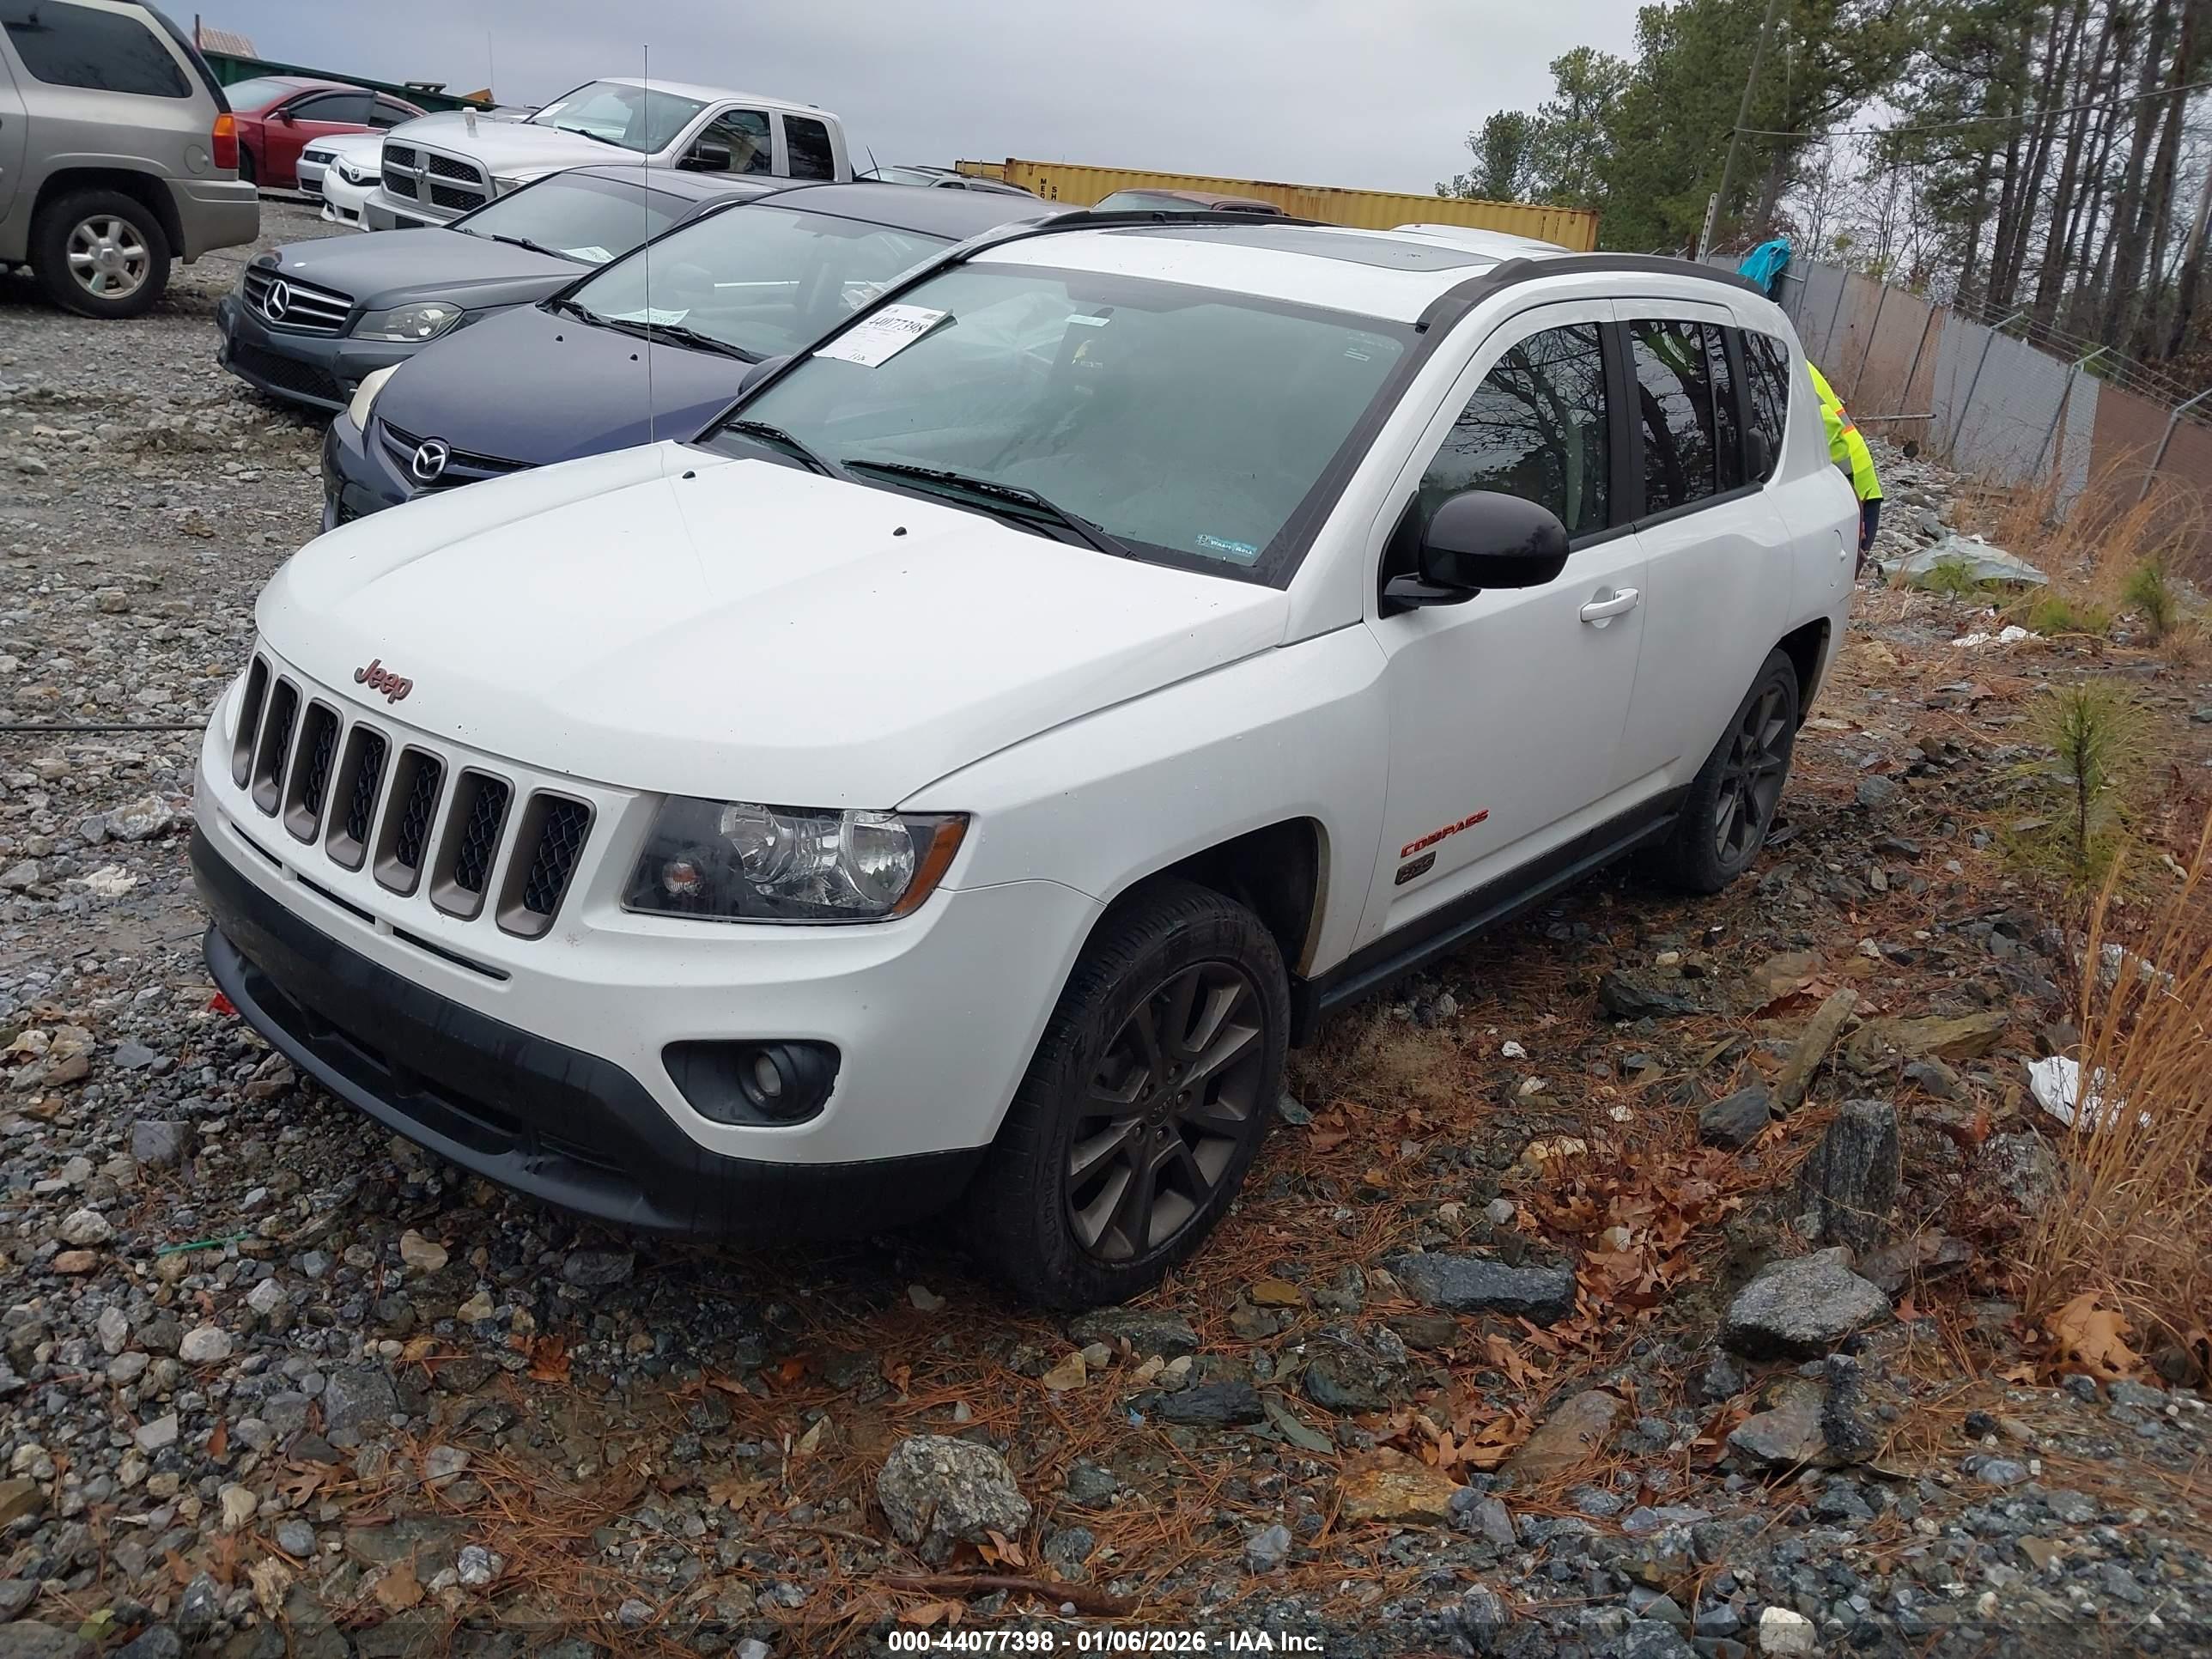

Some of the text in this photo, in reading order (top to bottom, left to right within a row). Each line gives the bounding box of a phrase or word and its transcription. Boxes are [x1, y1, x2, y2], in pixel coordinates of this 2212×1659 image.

[868, 316, 928, 334] 44077398
[354, 659, 413, 704] Jeep
[1401, 810, 1489, 859] COMPASS
